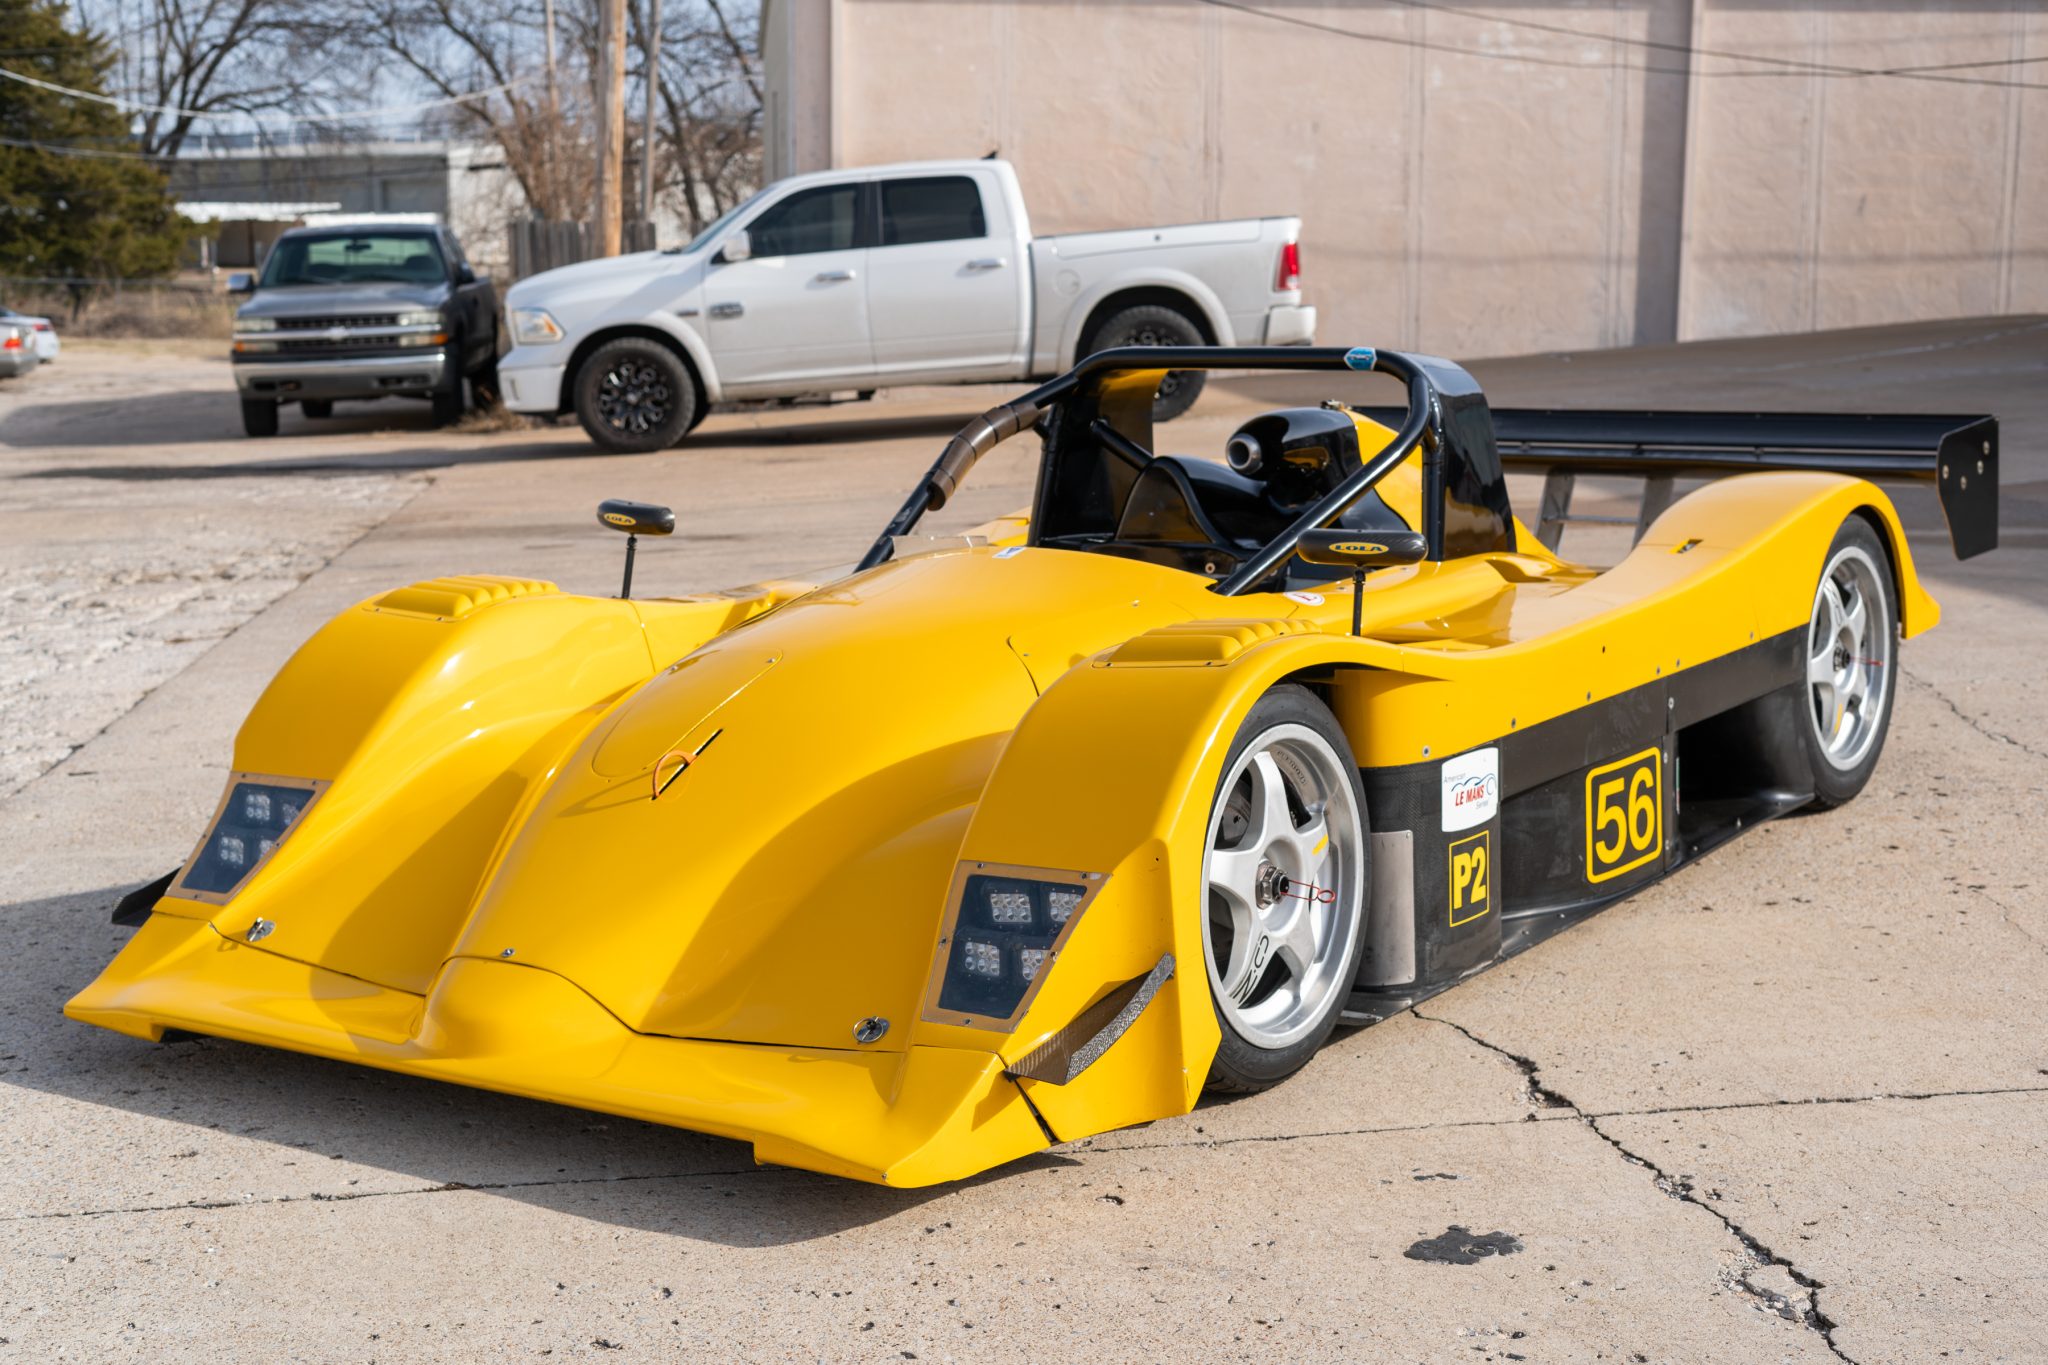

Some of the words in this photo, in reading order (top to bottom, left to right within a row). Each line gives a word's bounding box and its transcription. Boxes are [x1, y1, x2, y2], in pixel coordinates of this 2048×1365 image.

[1335, 544, 1384, 552] LOLA
[1455, 790, 1465, 807] LE
[1466, 784, 1485, 803] MANS
[1595, 766, 1656, 865] 56
[1453, 846, 1487, 910] P2
